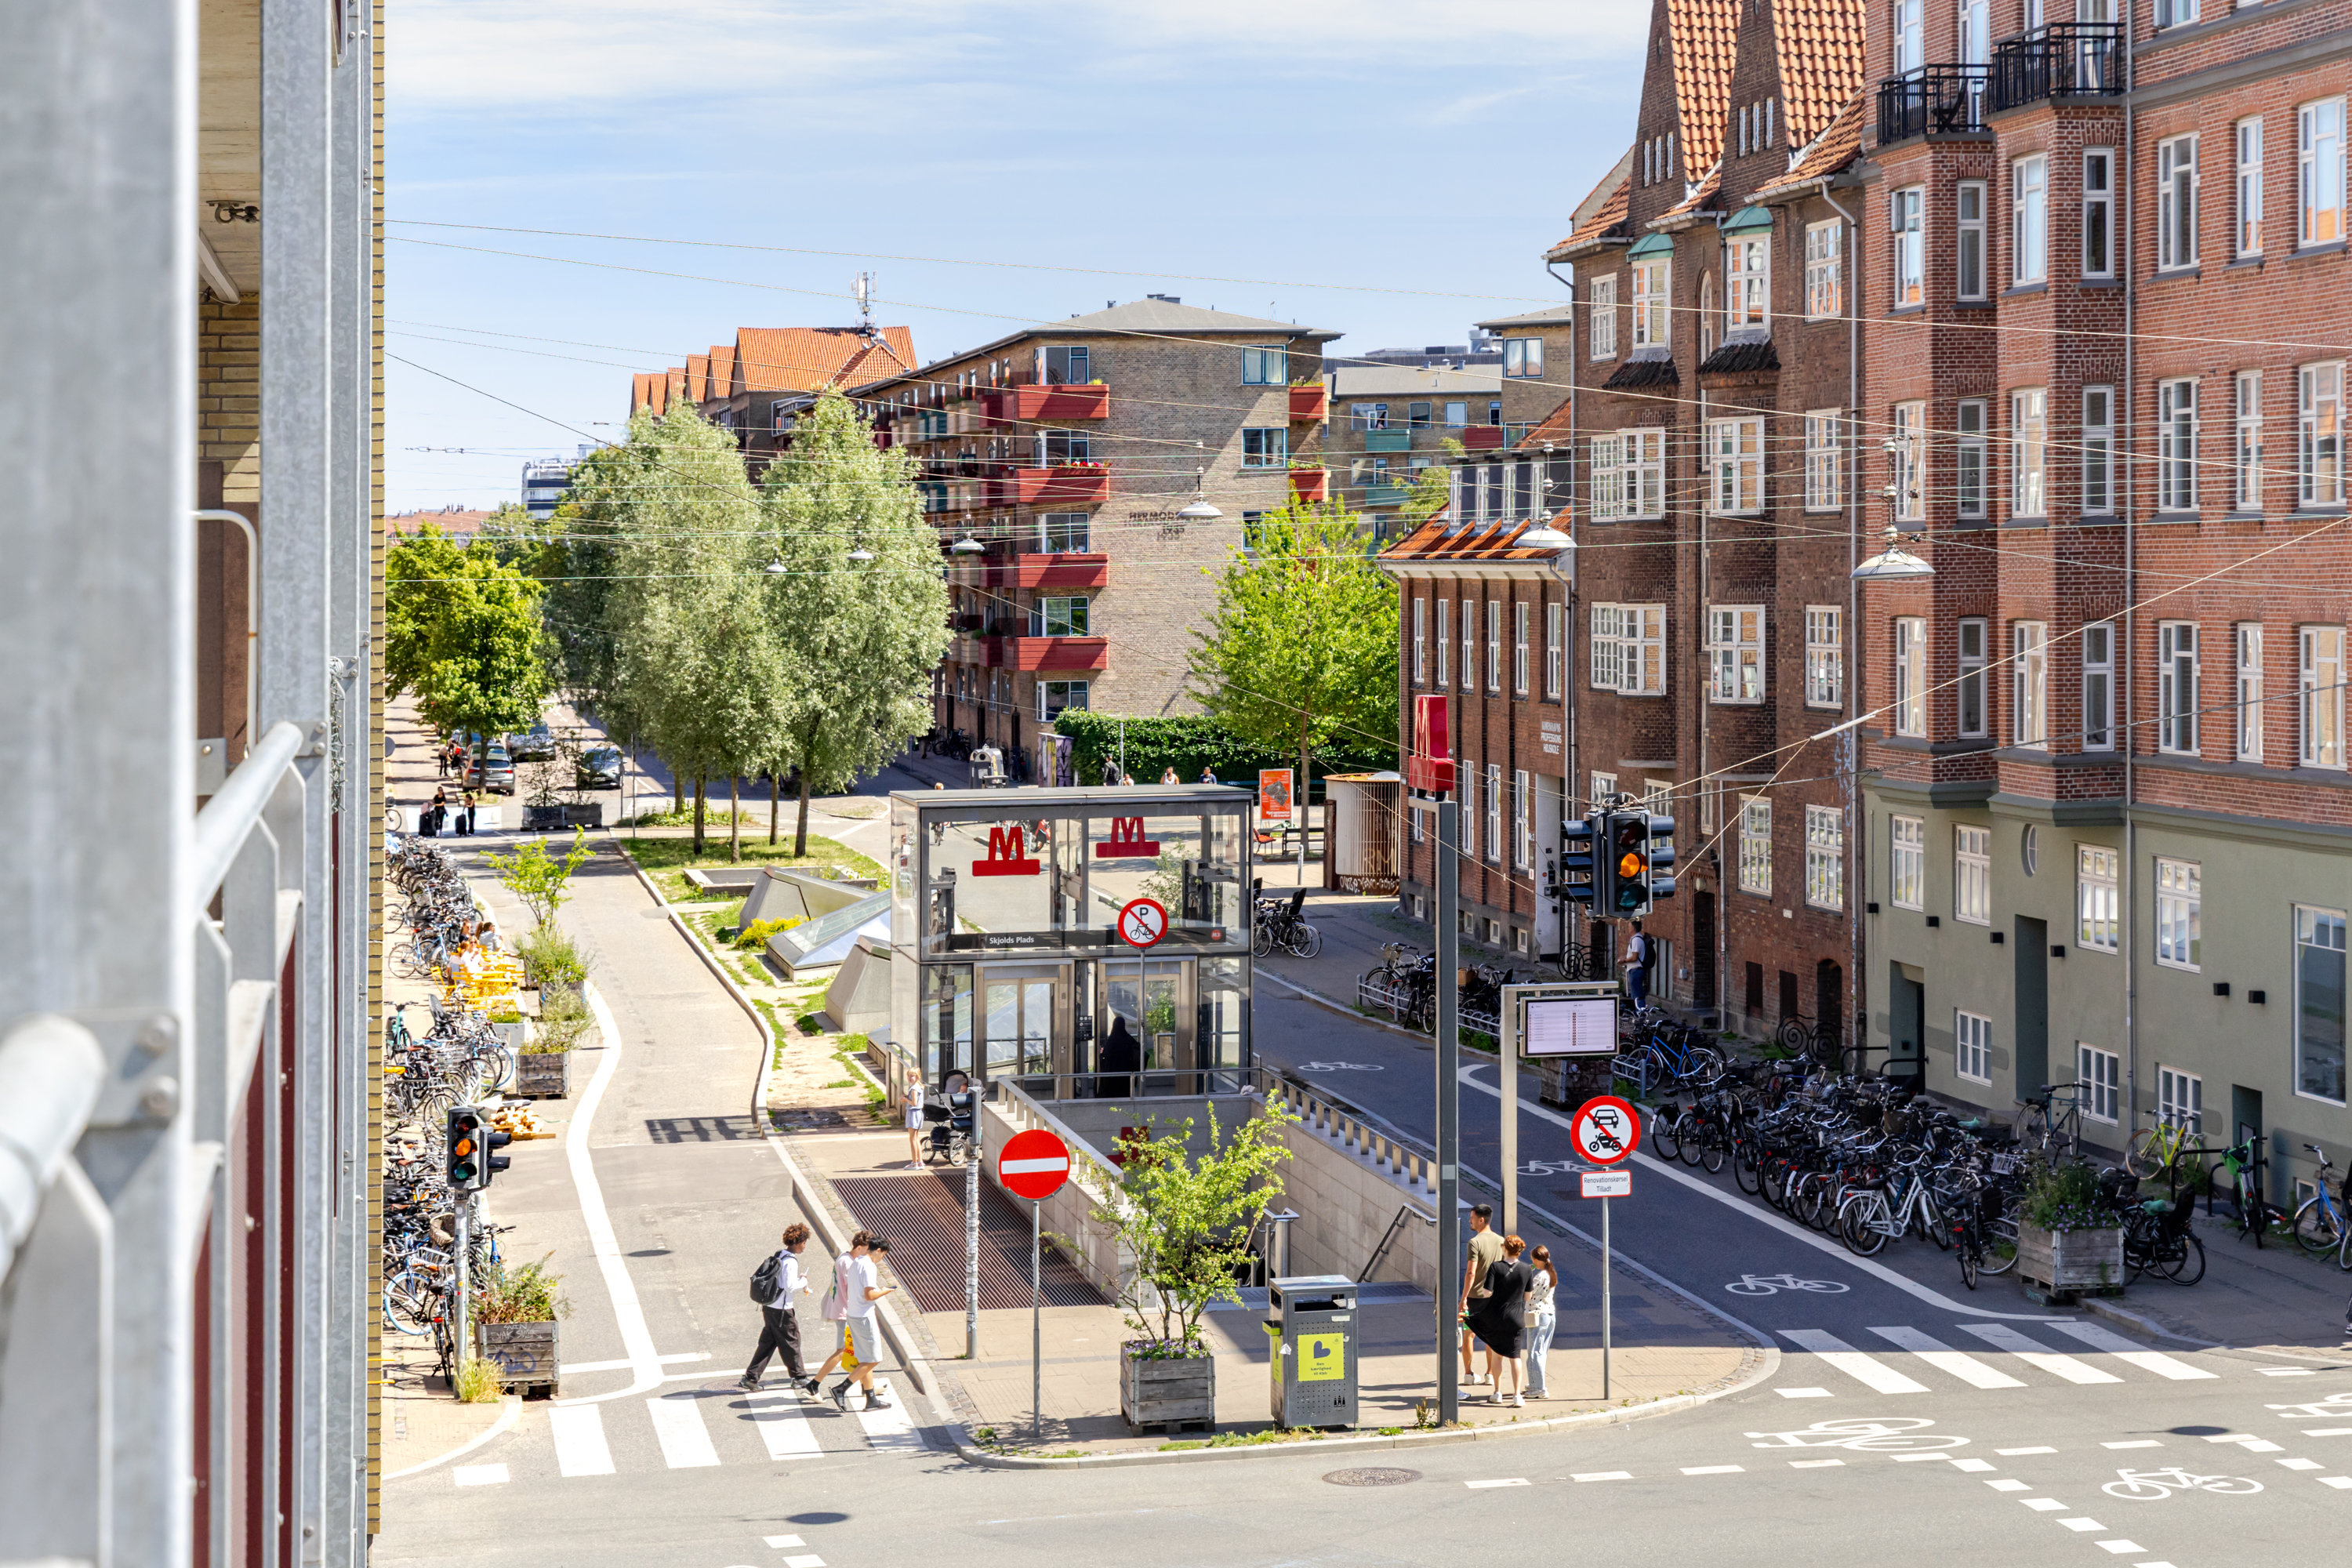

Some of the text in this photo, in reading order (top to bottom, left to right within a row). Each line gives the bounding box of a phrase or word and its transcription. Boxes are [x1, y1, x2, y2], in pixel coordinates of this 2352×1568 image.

[988, 827, 1025, 861] M
[1139, 907, 1149, 916] P
[989, 936, 1014, 946] Skjolds
